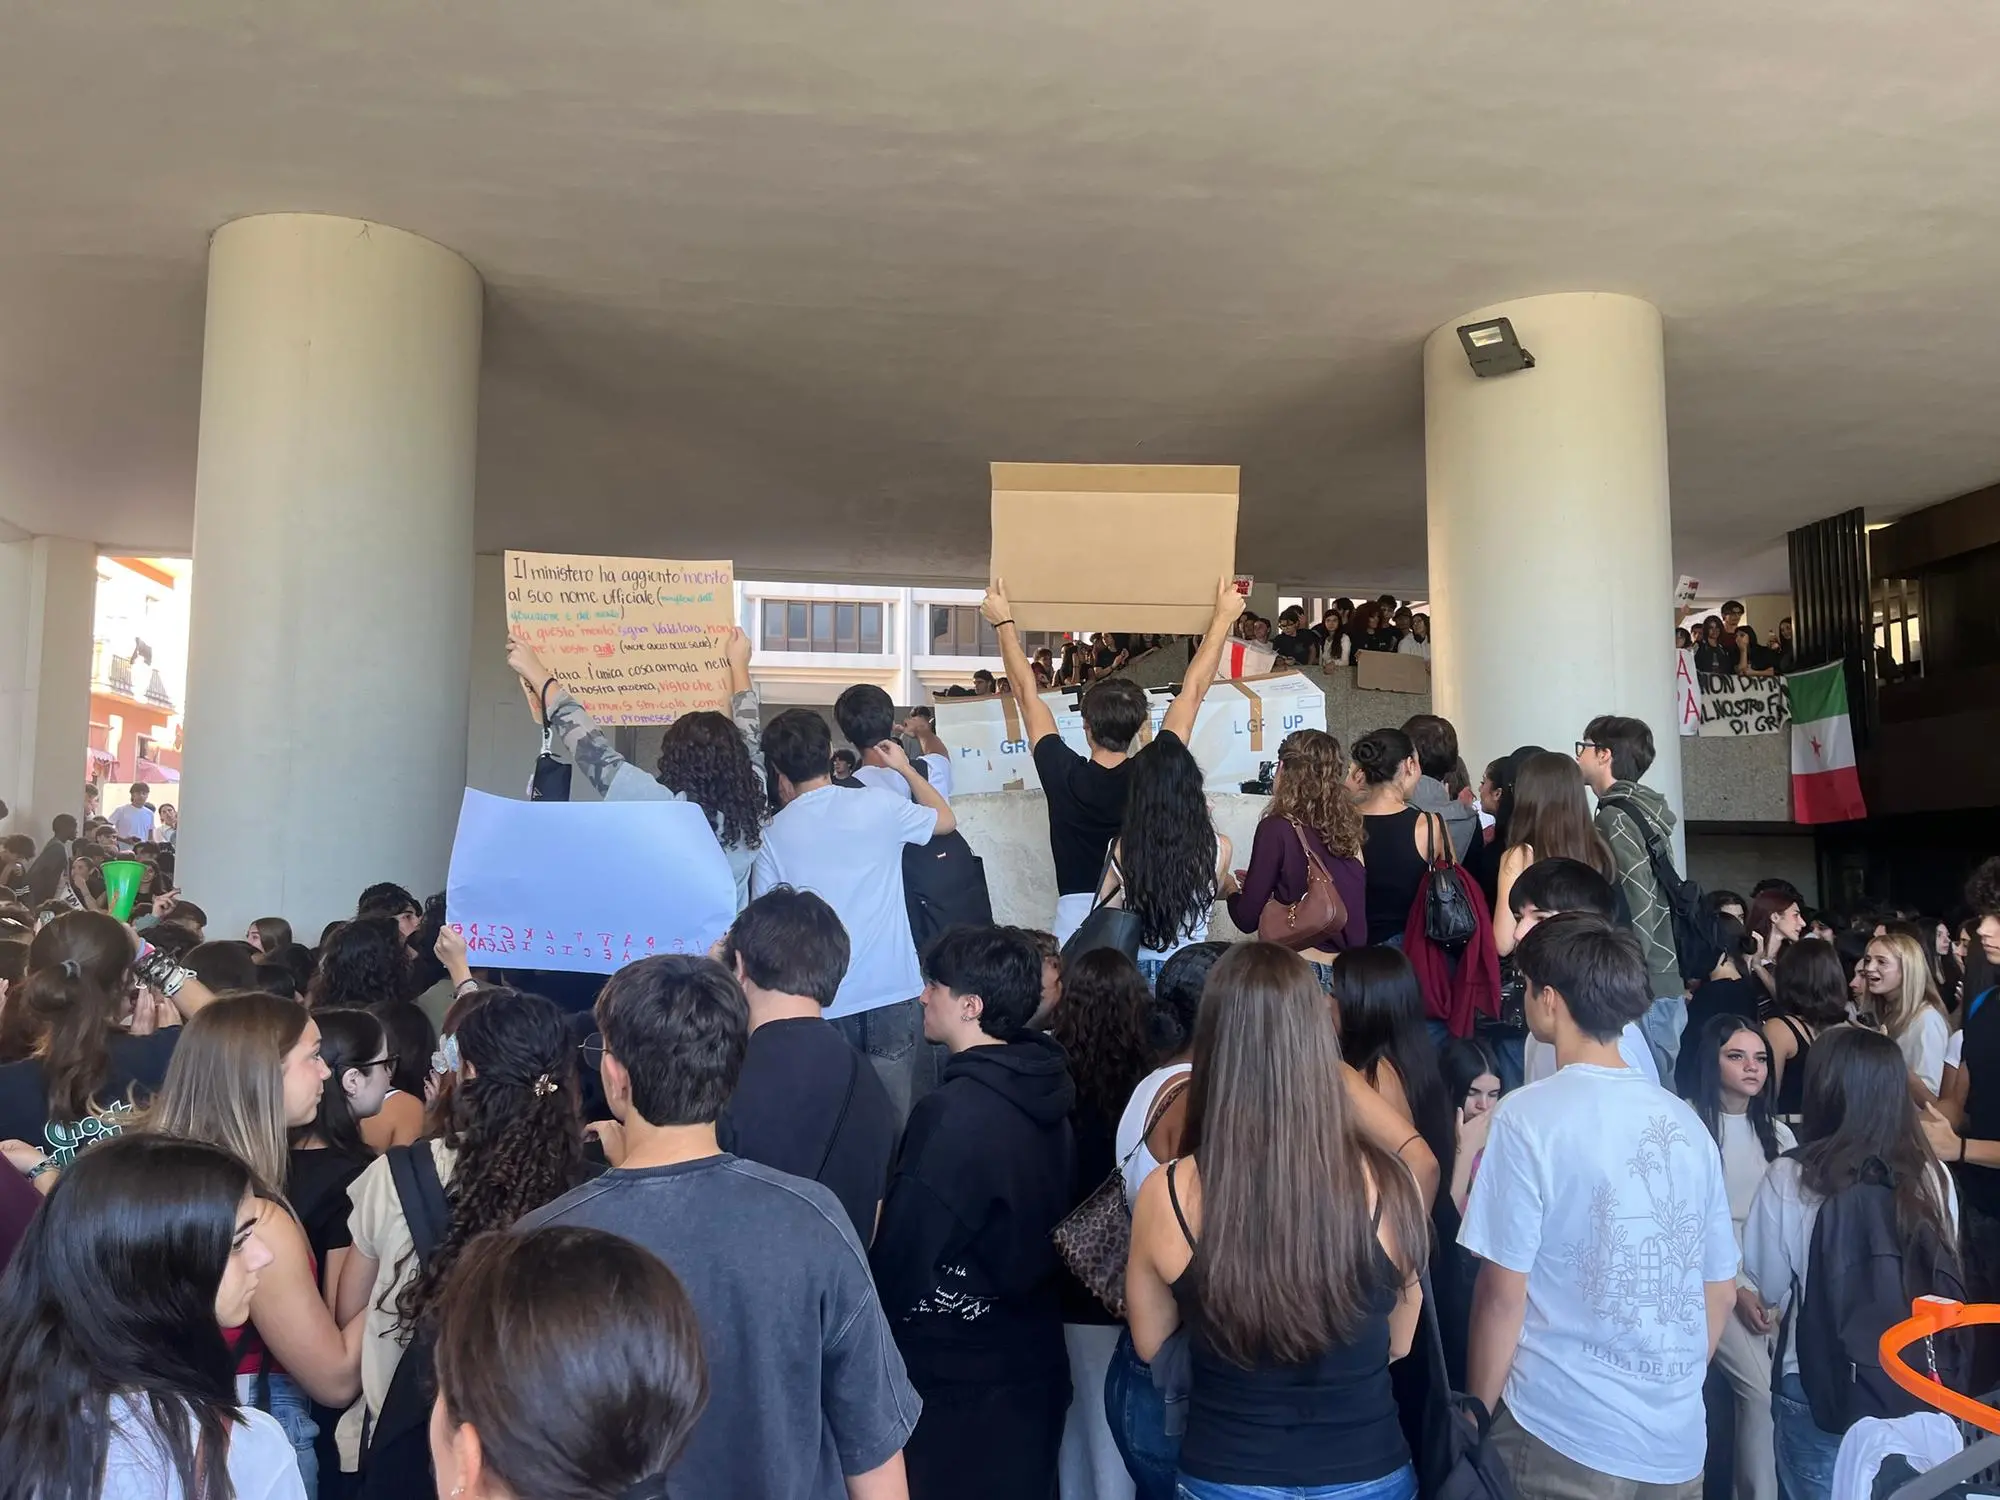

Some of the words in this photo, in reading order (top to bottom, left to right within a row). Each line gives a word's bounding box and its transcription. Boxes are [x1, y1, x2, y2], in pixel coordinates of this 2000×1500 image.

[513, 557, 527, 580] Il
[532, 564, 593, 581] ministero
[600, 564, 615, 583] ha
[508, 589, 520, 602] al
[528, 590, 553, 604] suo
[560, 592, 597, 603] nome
[1730, 718, 1748, 735] DI
[1638, 1360, 1663, 1376] DE
